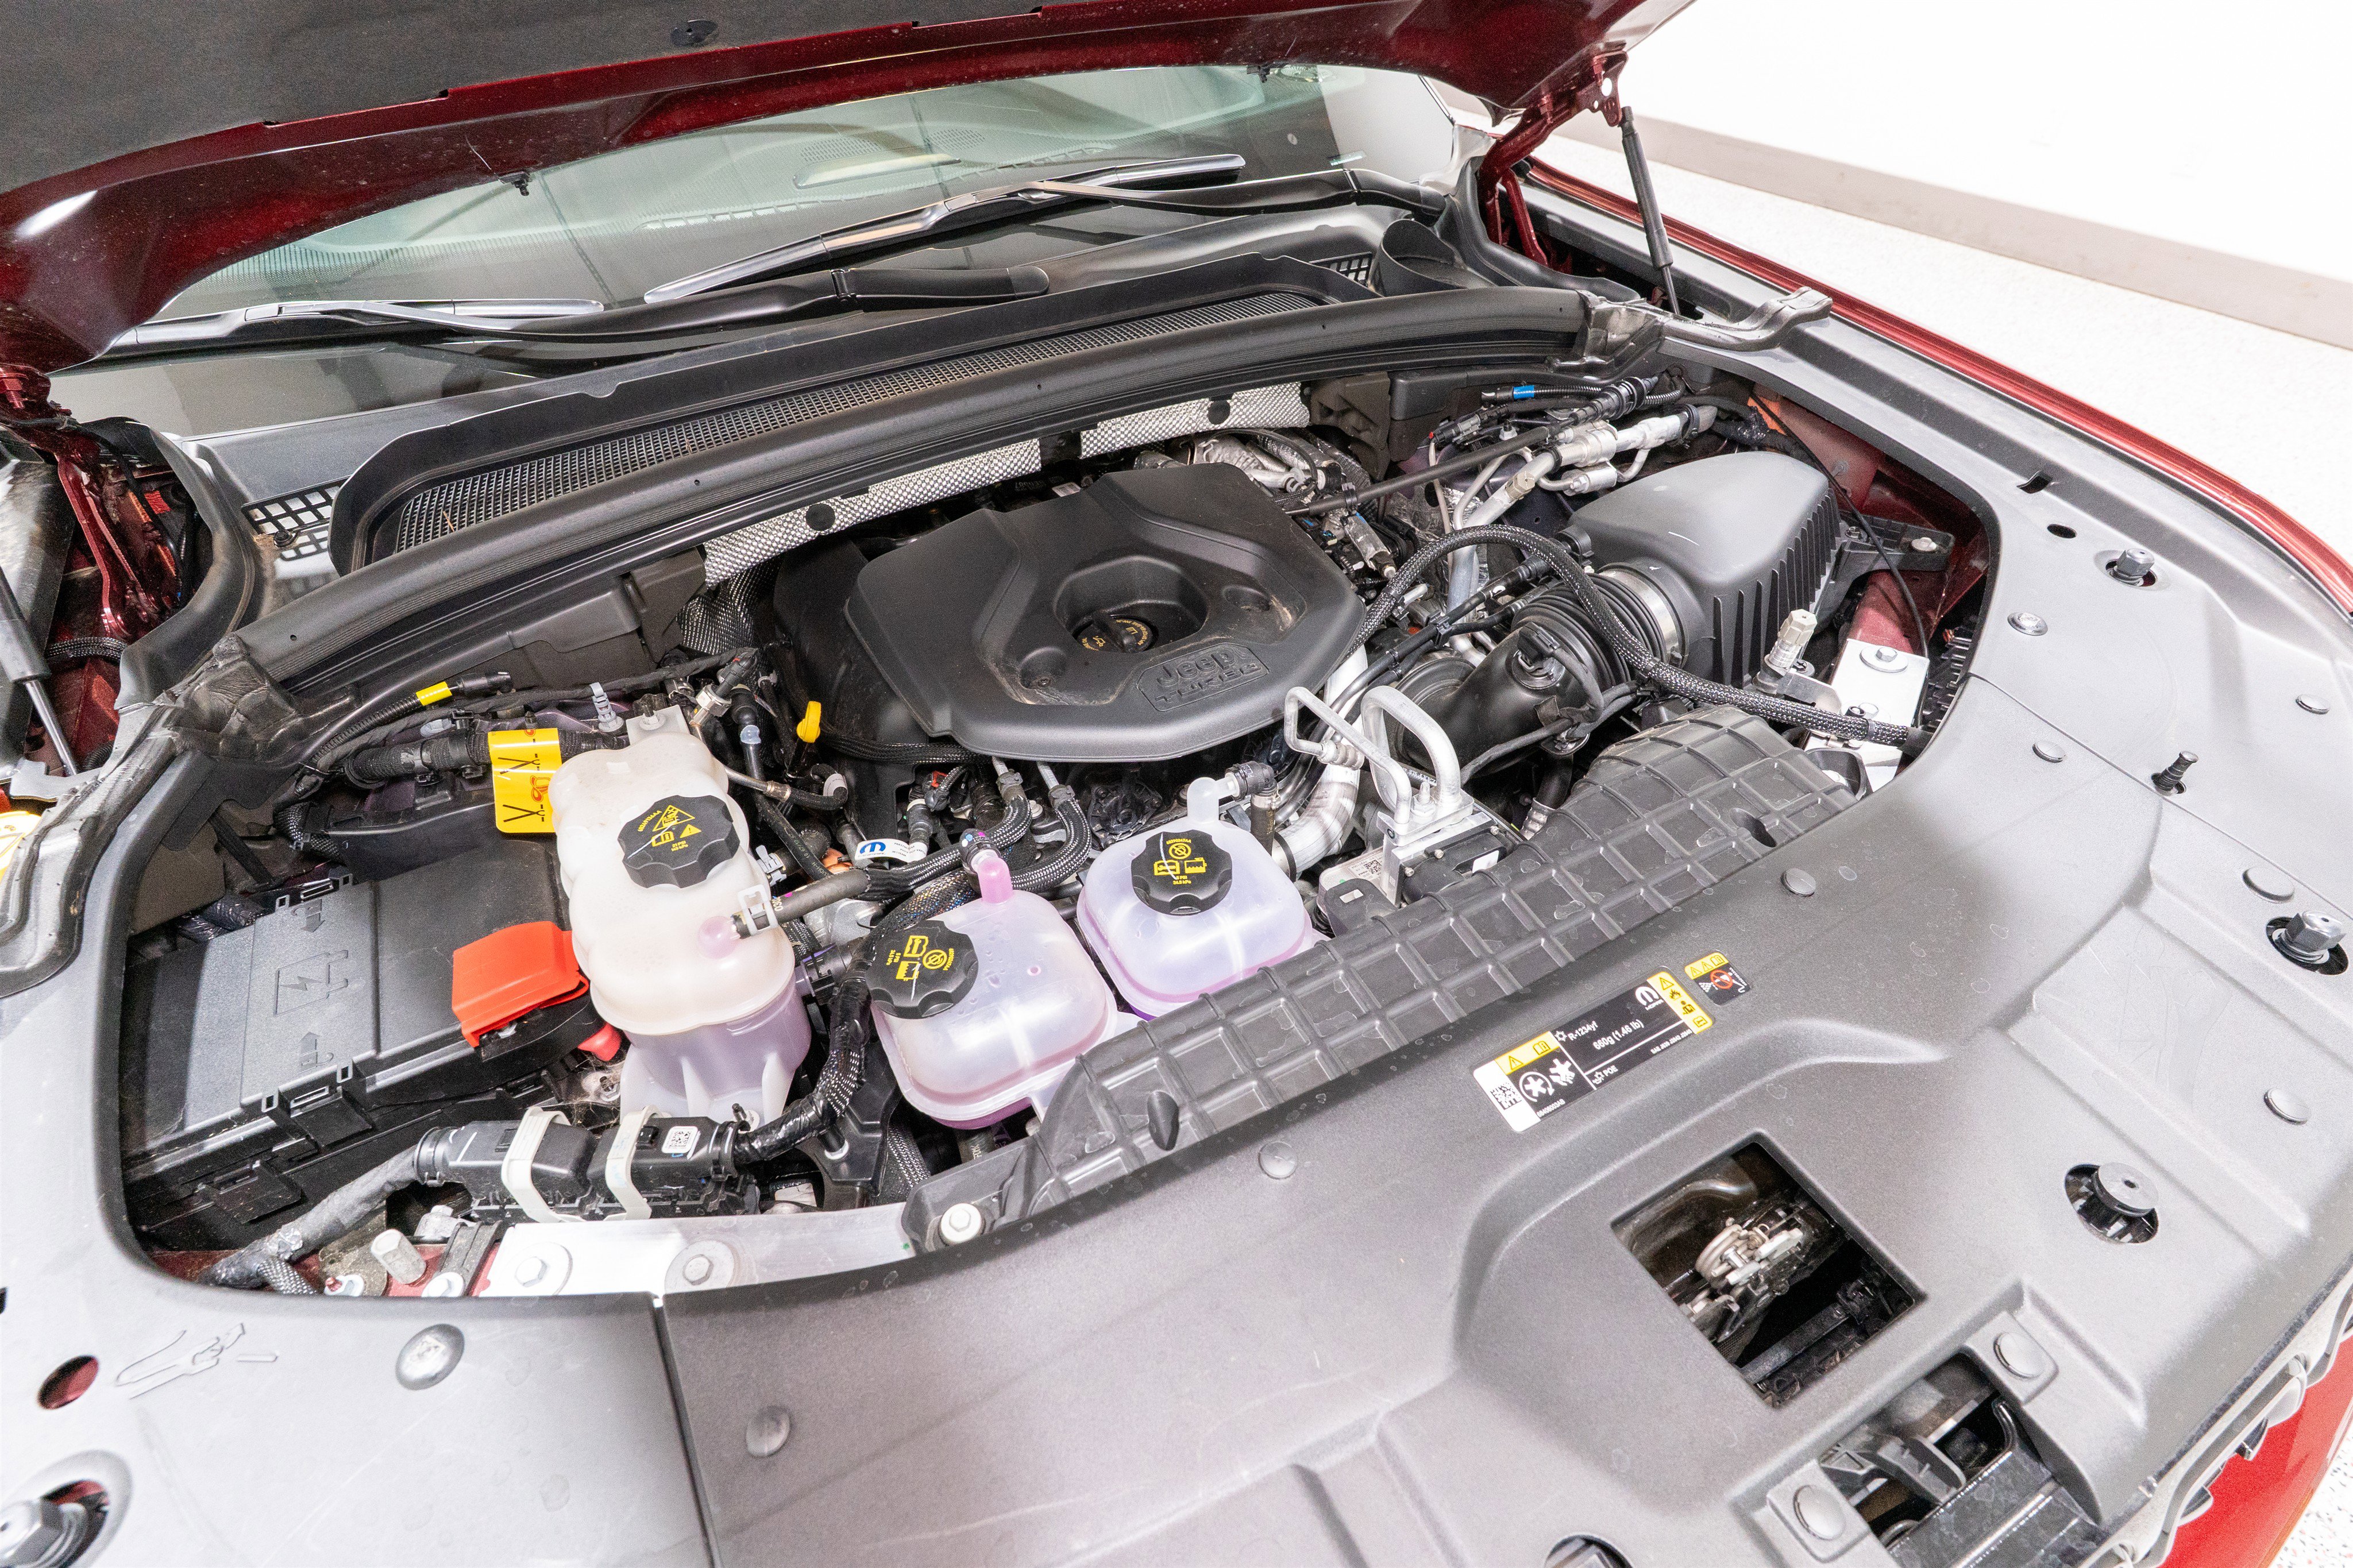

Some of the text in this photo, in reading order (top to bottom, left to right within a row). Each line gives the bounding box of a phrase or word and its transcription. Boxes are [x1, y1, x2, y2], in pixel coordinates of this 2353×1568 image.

[1156, 650, 1236, 686] Jeep
[1567, 1021, 1598, 1041] R-1234yf
[1593, 1019, 1645, 1050] 660g (1.46 lb)
[1602, 1065, 1618, 1077] POE
